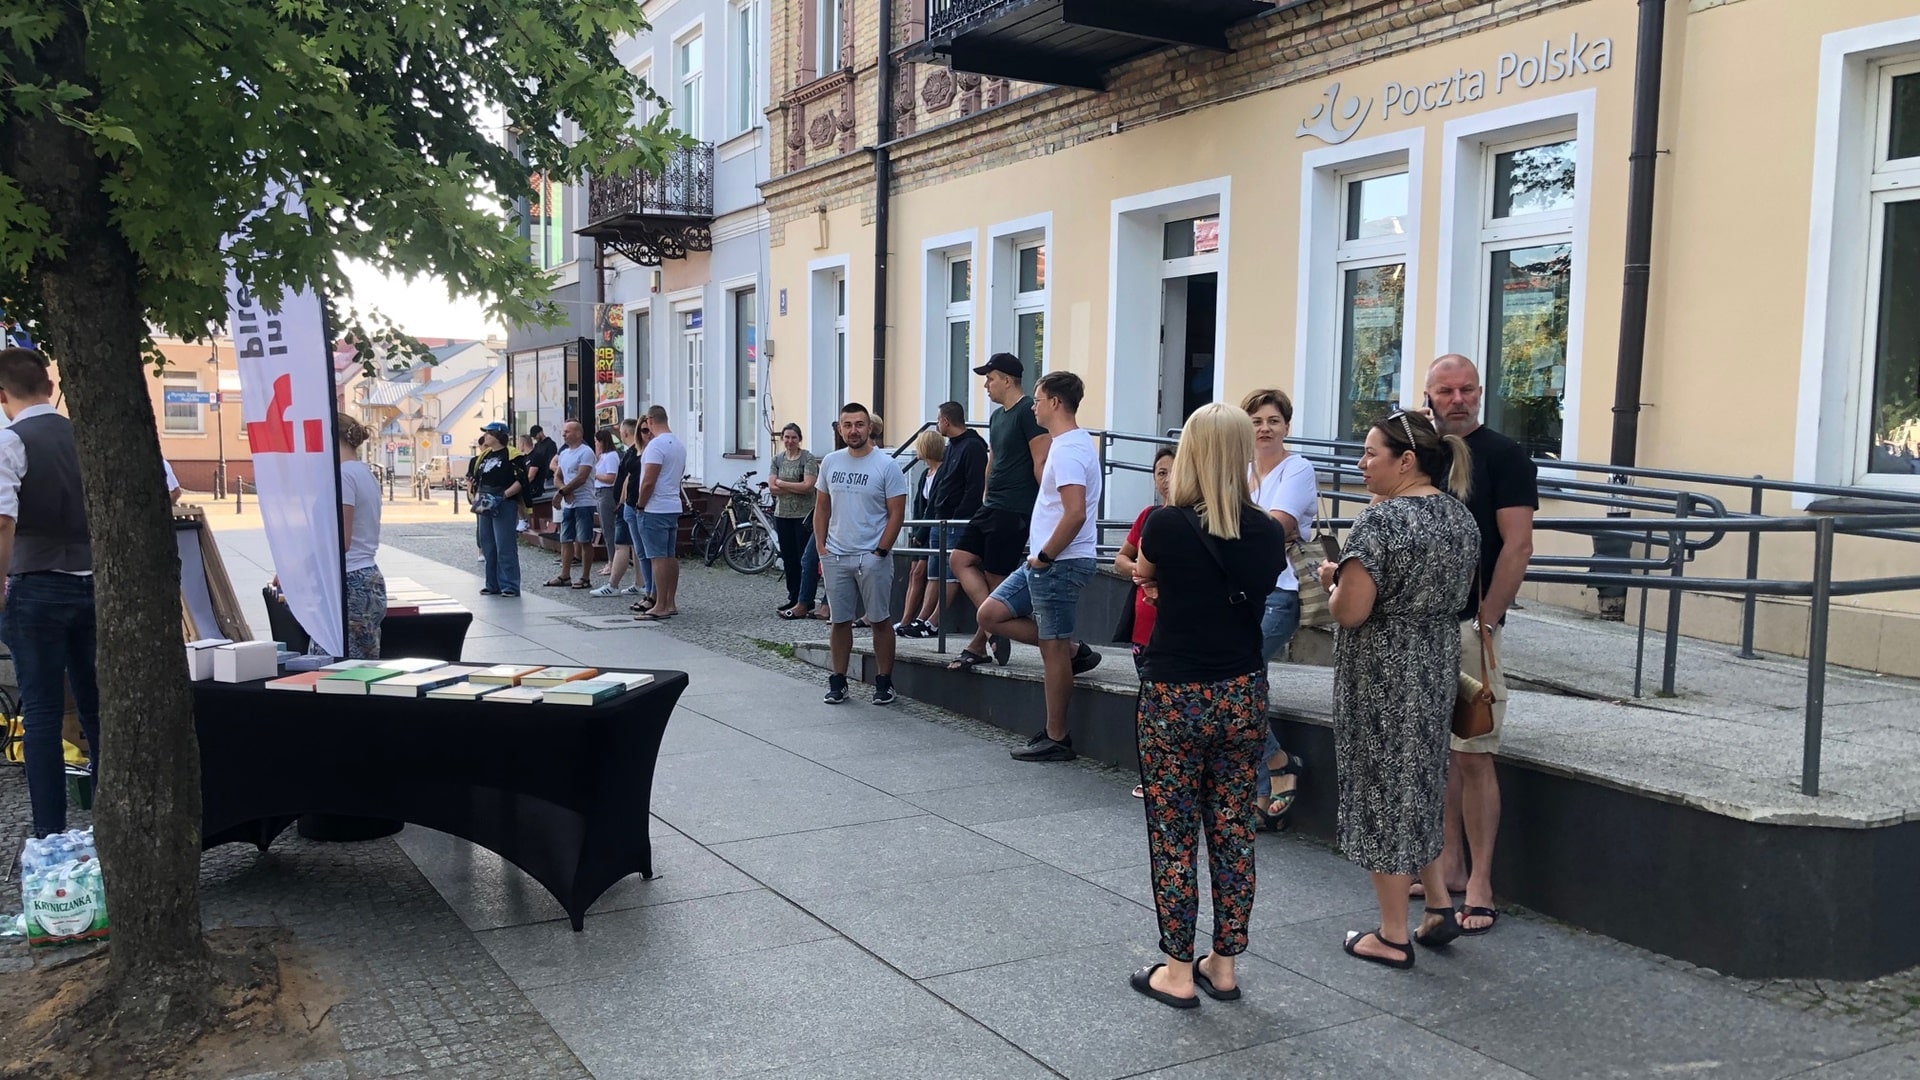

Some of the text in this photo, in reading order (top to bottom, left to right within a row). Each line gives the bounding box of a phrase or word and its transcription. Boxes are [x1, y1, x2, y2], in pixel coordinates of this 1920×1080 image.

[1382, 32, 1613, 121] Poczta Polska
[443, 435, 450, 443] P
[831, 471, 869, 486] BIG STAR
[33, 894, 92, 912] KRYNICZANKA
